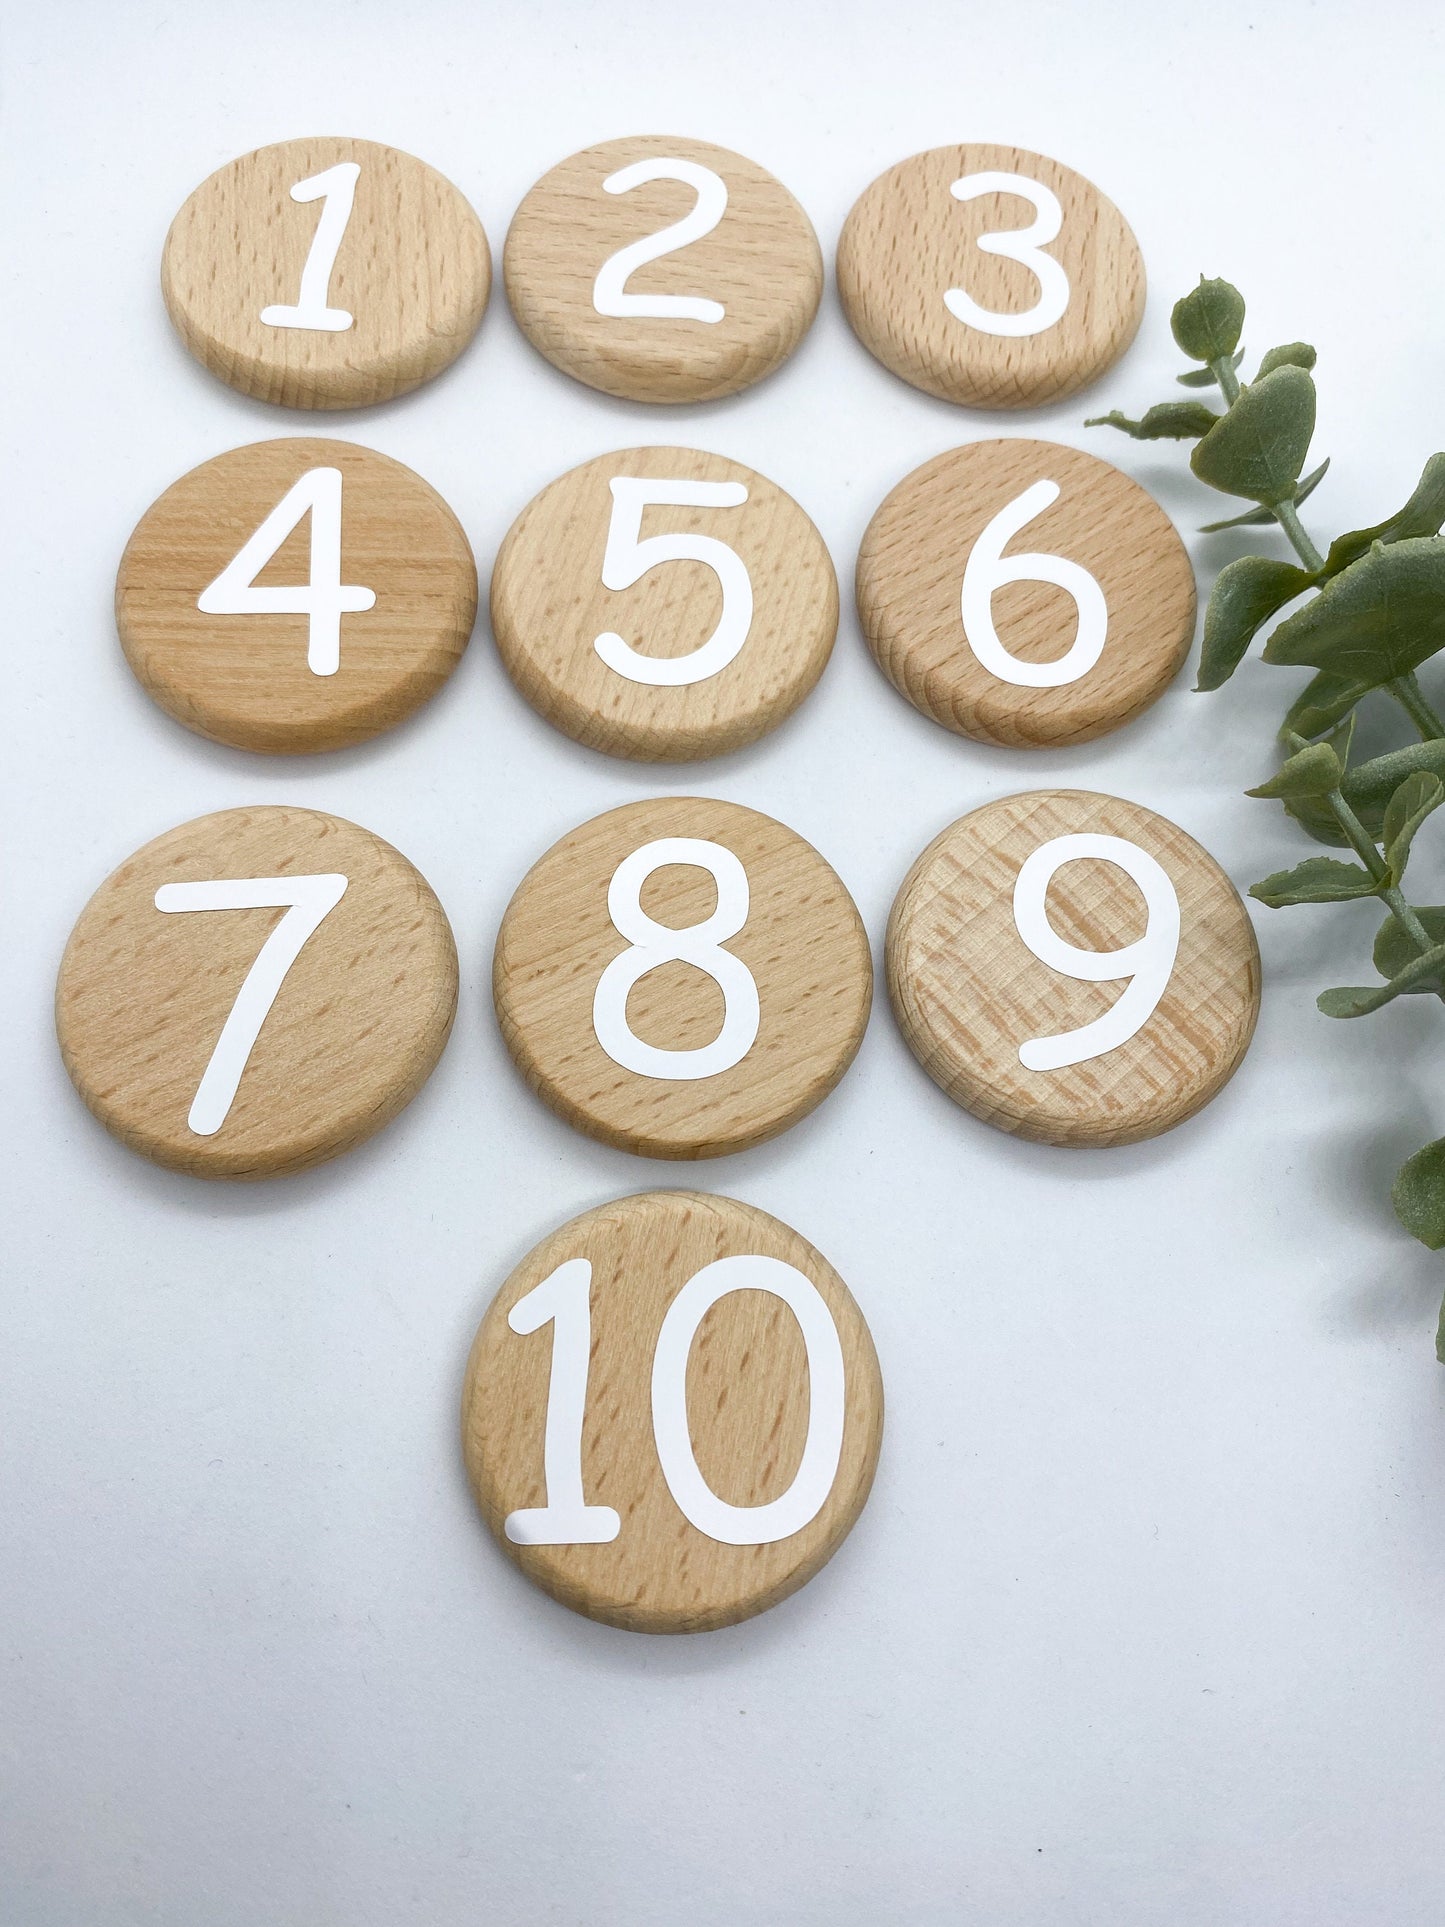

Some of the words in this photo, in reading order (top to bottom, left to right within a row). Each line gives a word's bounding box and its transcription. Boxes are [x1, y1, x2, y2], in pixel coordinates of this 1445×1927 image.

[259, 160, 361, 331] 1
[592, 156, 729, 324] 2
[943, 170, 1071, 337] 3
[197, 467, 376, 676] 4
[594, 475, 754, 686] 5
[961, 479, 1108, 687] 6
[154, 873, 348, 1135] 7
[593, 837, 760, 1080] 8
[1012, 832, 1181, 1071] 9
[504, 1254, 845, 1545] 10
